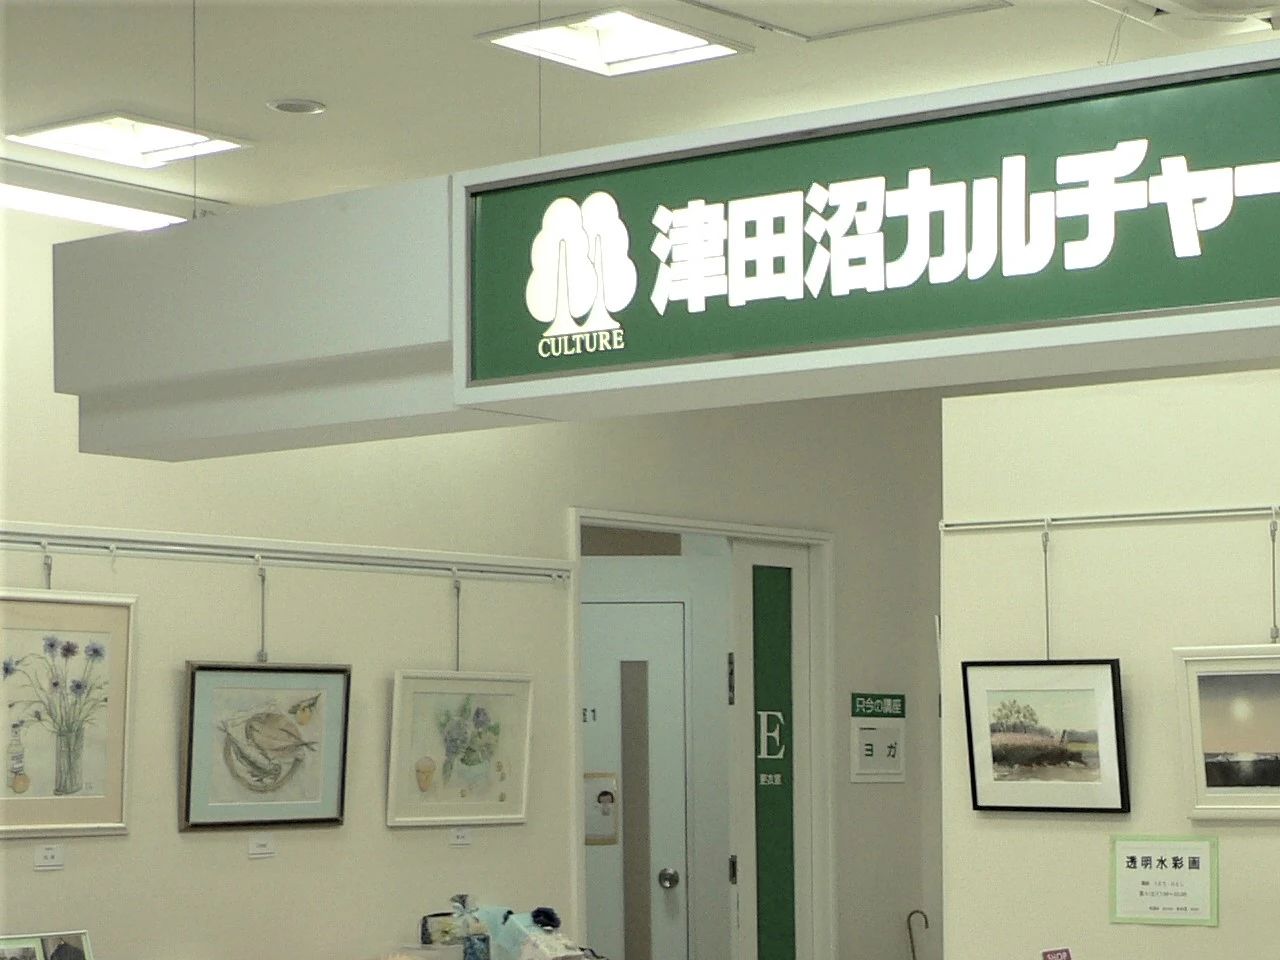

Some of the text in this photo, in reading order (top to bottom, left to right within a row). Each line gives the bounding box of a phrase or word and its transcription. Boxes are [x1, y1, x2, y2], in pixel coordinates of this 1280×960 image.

[538, 329, 624, 357] CULTURE
[757, 711, 786, 758] E
[1126, 855, 1200, 870] 透明水彩画
